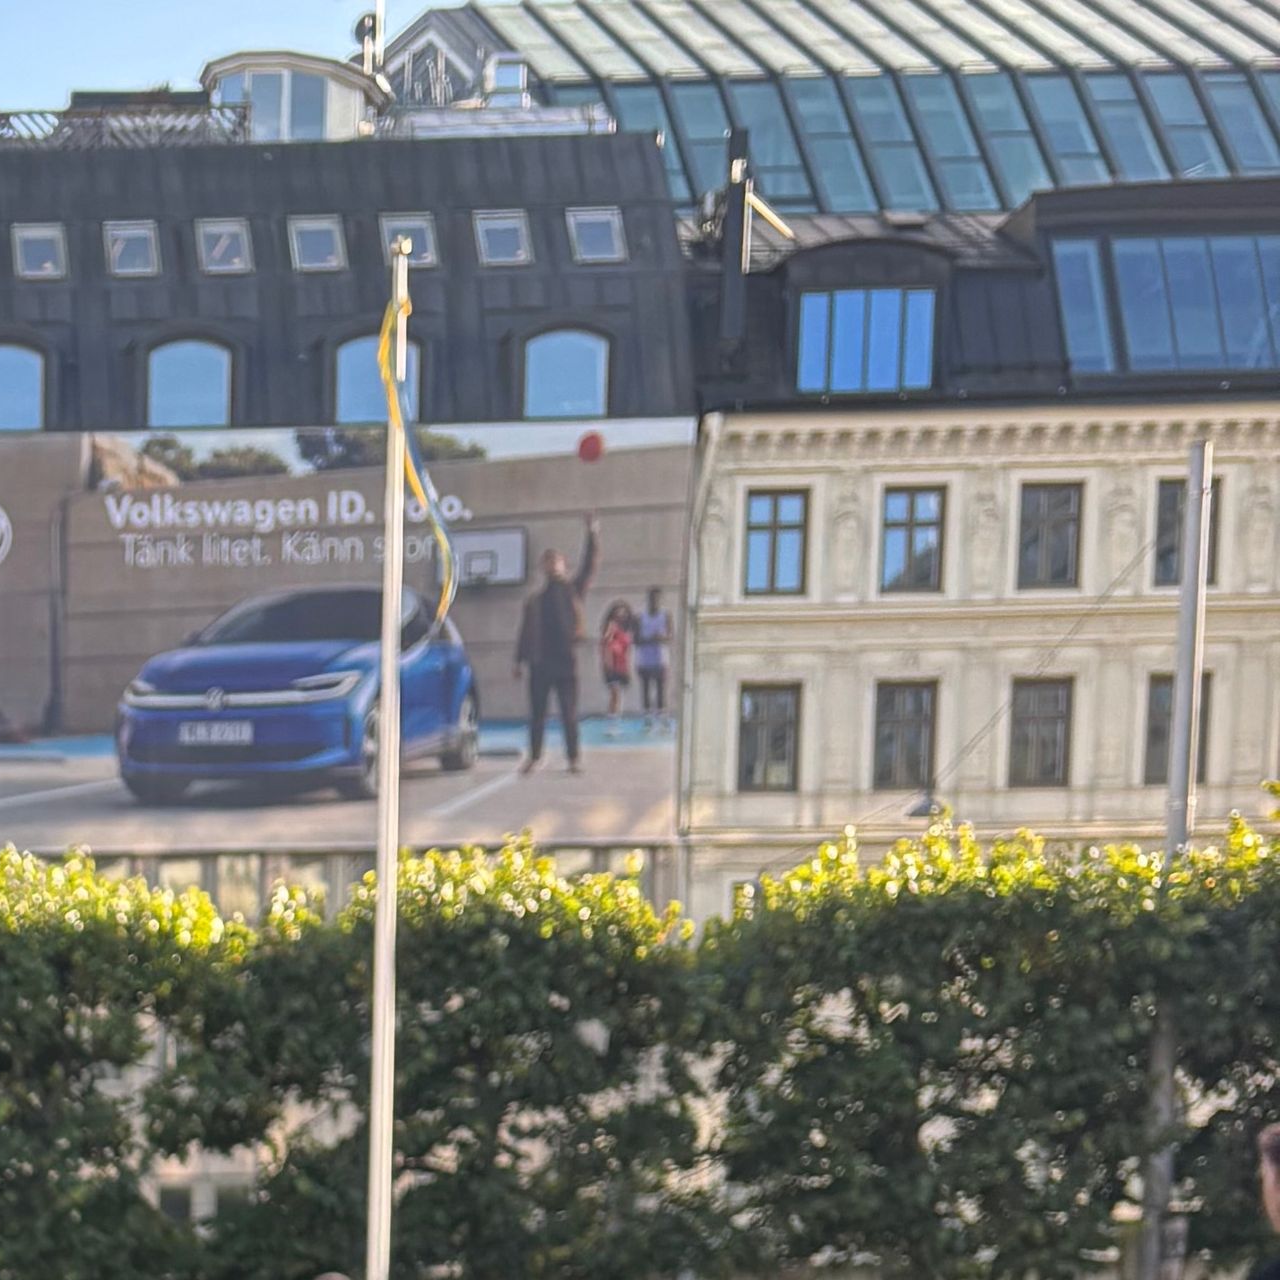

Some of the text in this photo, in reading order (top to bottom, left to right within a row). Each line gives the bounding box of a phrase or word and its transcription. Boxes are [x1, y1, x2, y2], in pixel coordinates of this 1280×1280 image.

[105, 493, 319, 533] Volkswagen
[328, 490, 375, 524] ID.
[120, 533, 194, 567] Tänk
[282, 530, 365, 565] Känn
